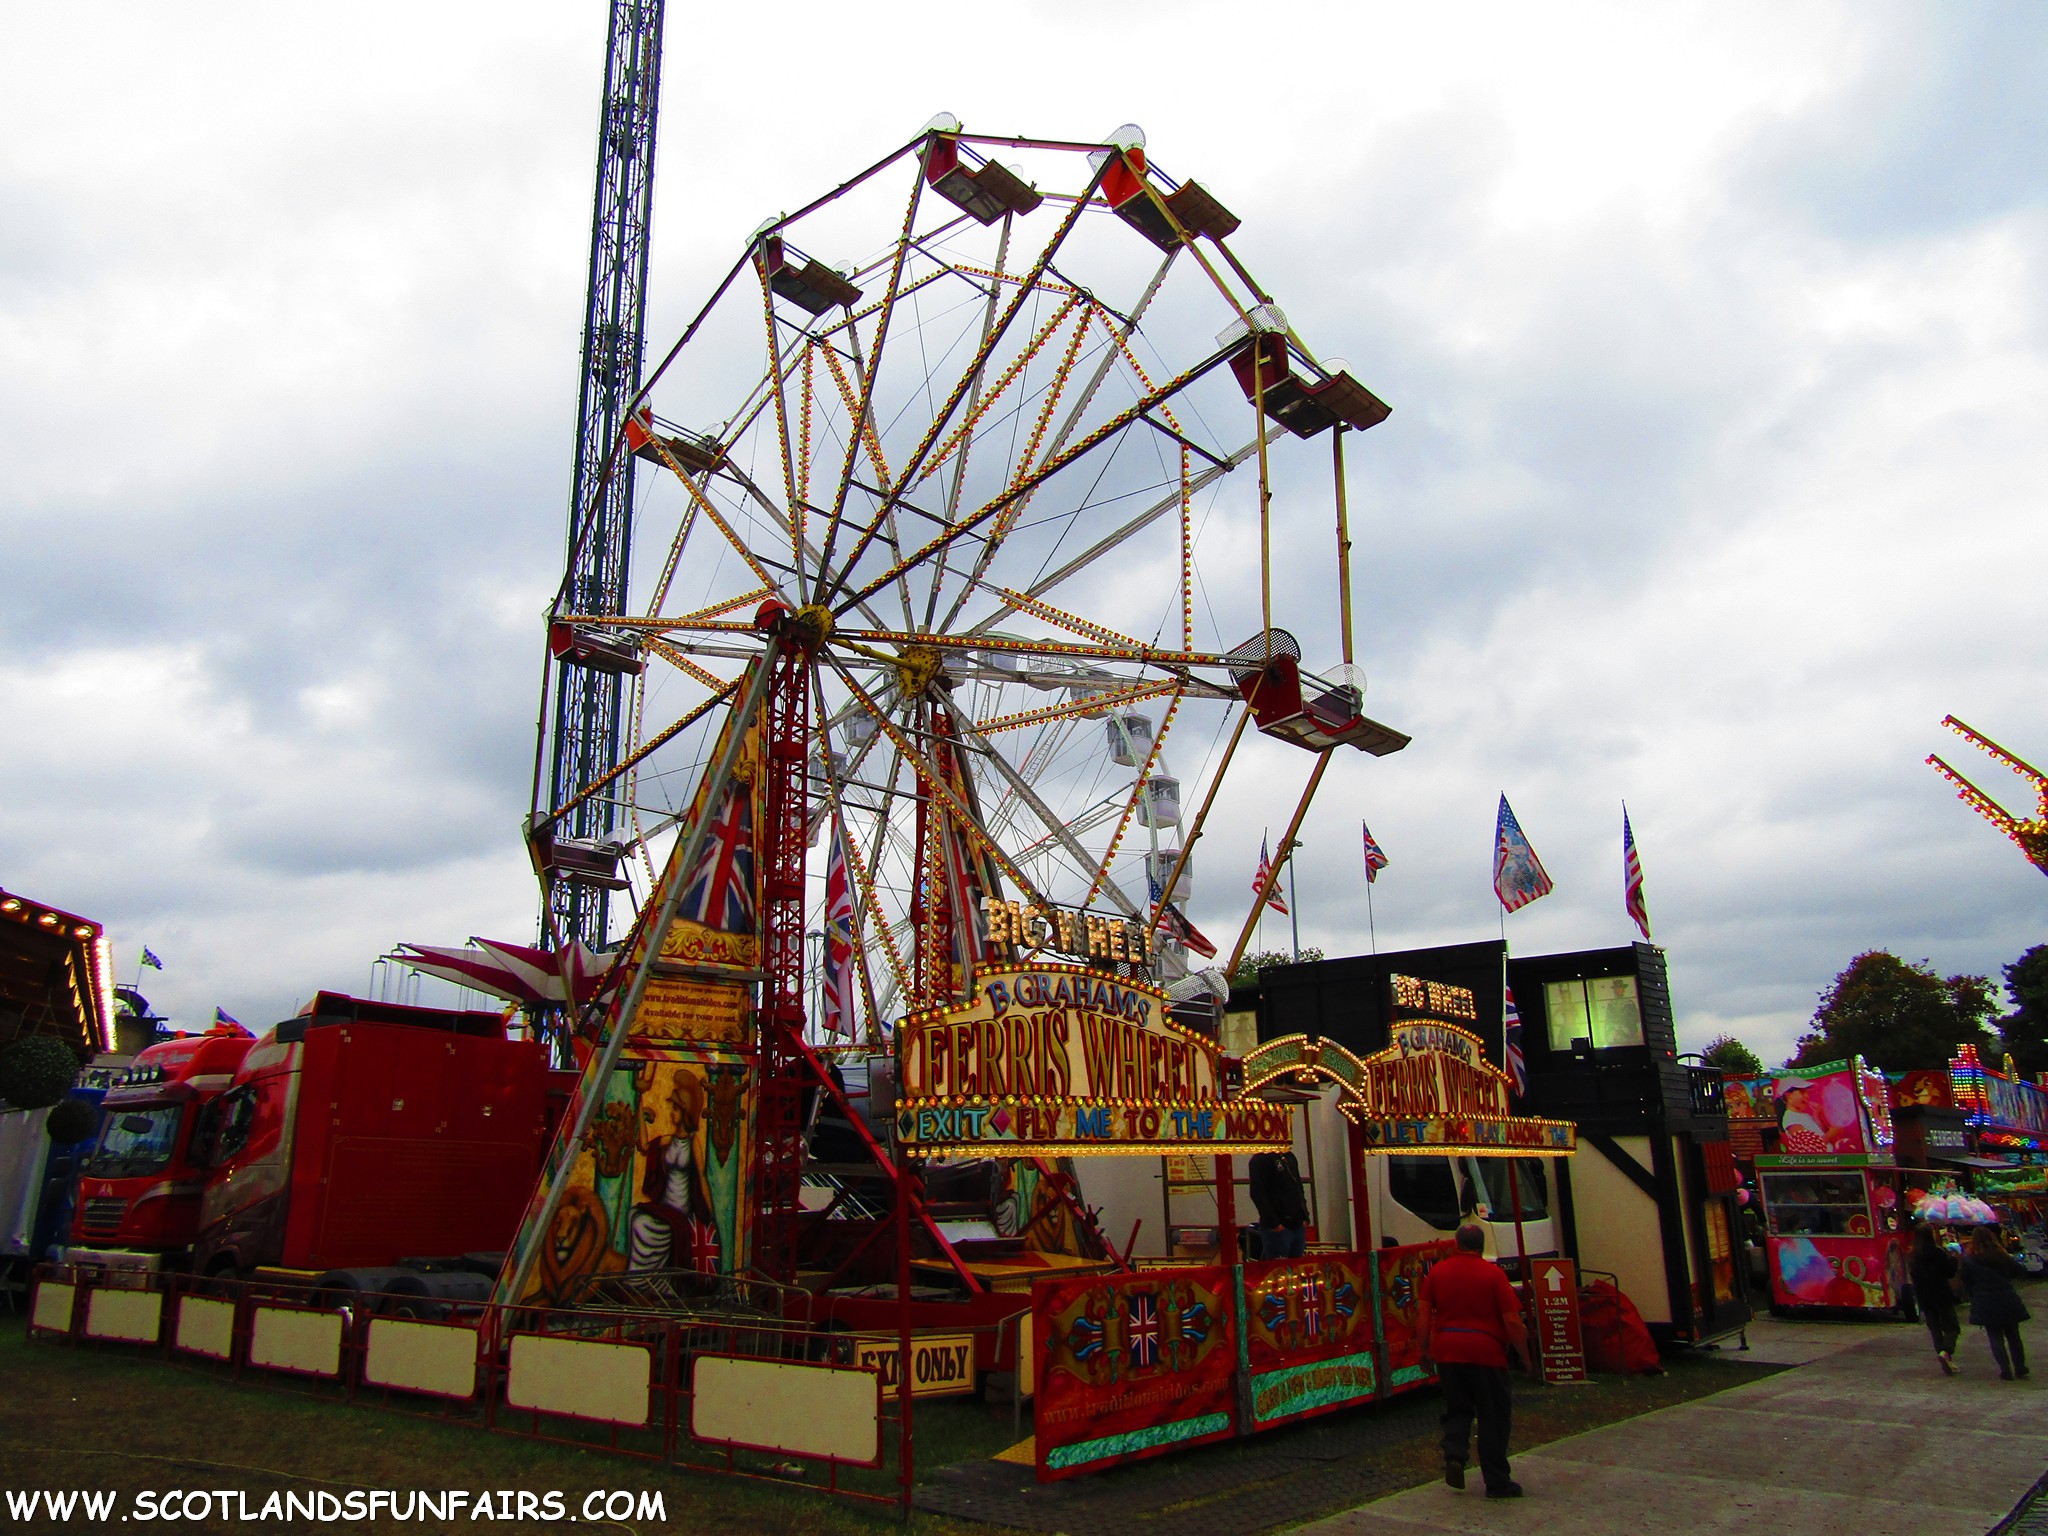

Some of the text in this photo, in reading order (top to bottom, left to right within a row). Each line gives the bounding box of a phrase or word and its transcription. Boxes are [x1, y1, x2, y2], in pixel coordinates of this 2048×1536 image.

[984, 897, 1155, 966] BIG WHEEL
[644, 1009, 681, 1018] Available
[683, 1011, 695, 1020] for
[1397, 975, 1477, 1020] BIG WHEEL
[918, 1008, 1071, 1097] FERRIS
[1078, 1011, 1207, 1101] WHEEL
[1370, 1052, 1439, 1115] FERRIS
[1440, 1052, 1505, 1116] WHEEL
[918, 1107, 1288, 1140] EXIT FLY ME TO THE MOON
[1385, 1120, 1568, 1146] LET ME PLAY AMONG THE
[1543, 1297, 1569, 1306] 1.2M
[916, 1345, 969, 1383] ONLY
[1043, 1378, 1230, 1425] www.traditionalrides.com
